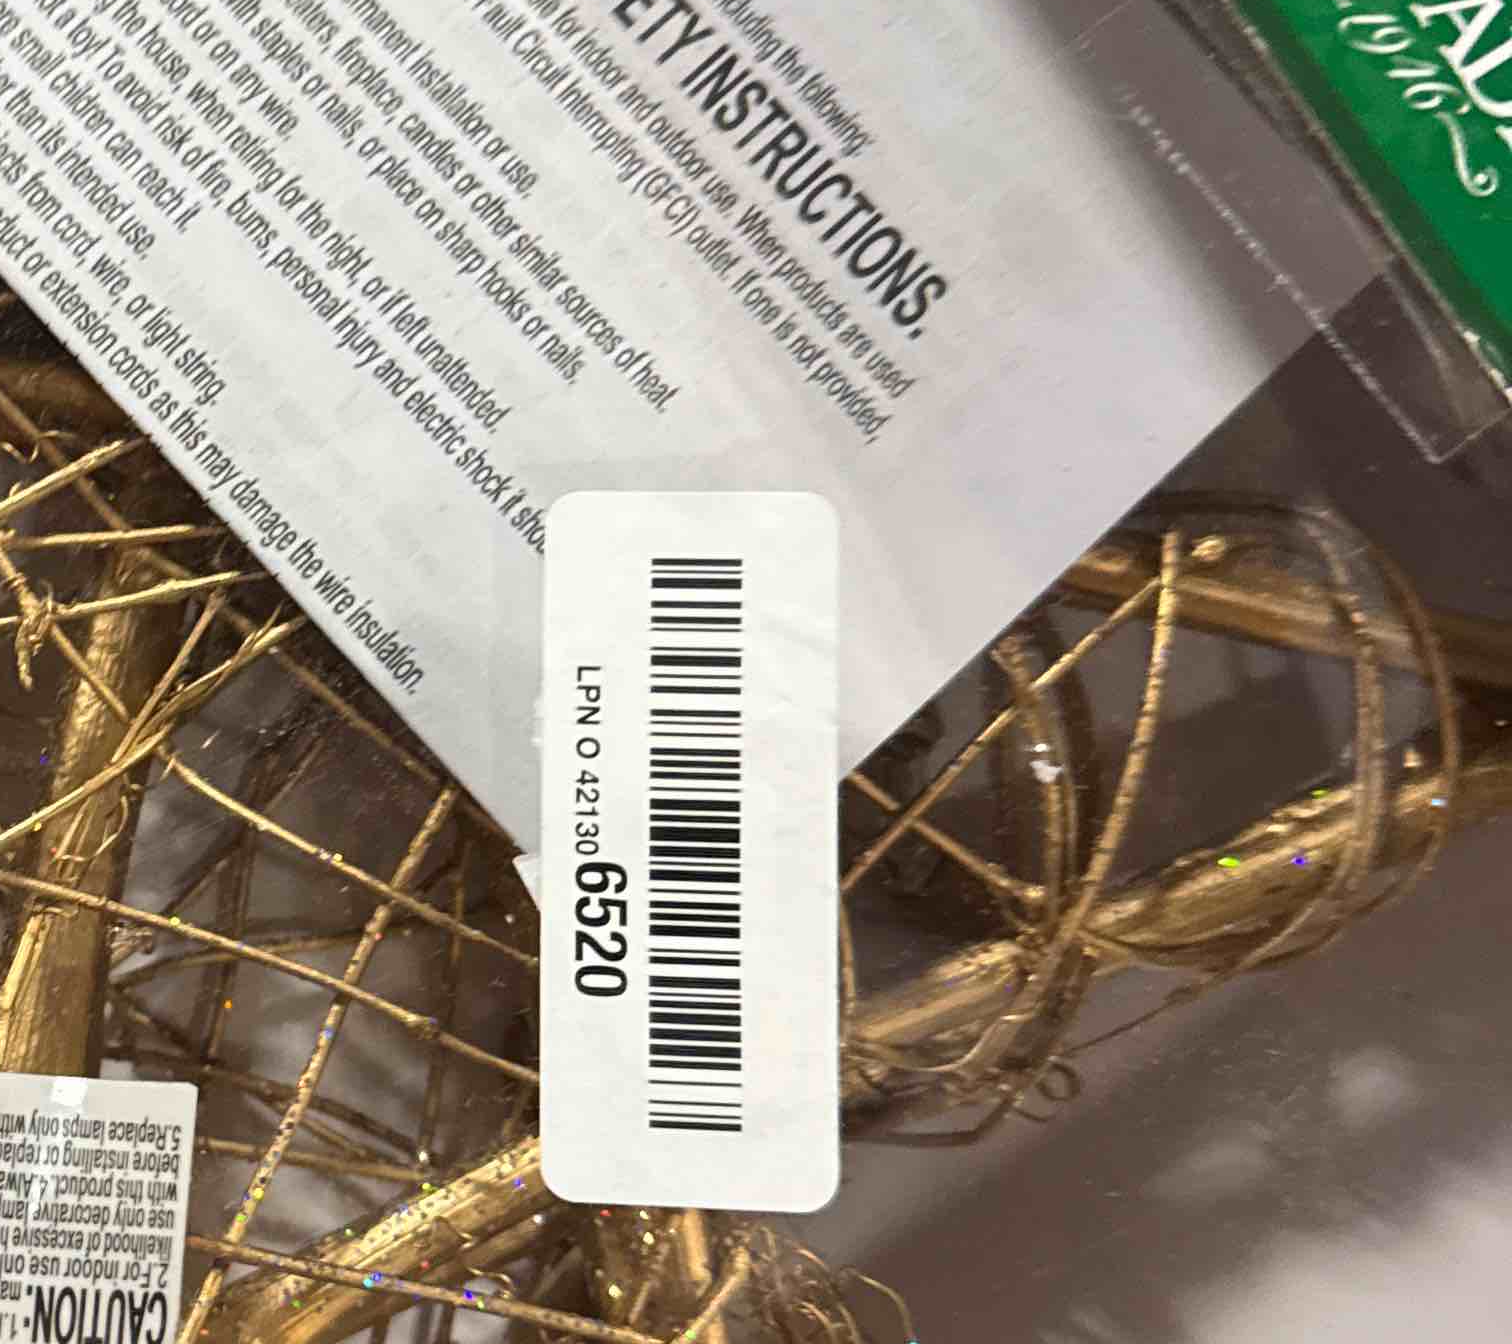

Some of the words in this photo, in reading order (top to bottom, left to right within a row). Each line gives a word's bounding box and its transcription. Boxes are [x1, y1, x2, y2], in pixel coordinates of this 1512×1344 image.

[133, 21, 196, 94] house,
[183, 77, 238, 135] when
[2, 85, 51, 138] than
[34, 119, 70, 158] its
[53, 140, 136, 225] intended
[115, 213, 159, 261] use.
[220, 121, 288, 194] retiring
[16, 169, 66, 224] from
[272, 173, 311, 213] for
[677, 41, 954, 342] INSTRUCTIONS.
[294, 197, 335, 240] the
[47, 209, 104, 268] cord,
[316, 227, 376, 289] night,
[86, 249, 136, 307] wire,
[359, 274, 391, 303] or
[123, 292, 156, 322] or
[376, 287, 410, 317] if
[137, 305, 192, 361] light
[387, 300, 431, 344] left
[170, 344, 231, 409] string.
[412, 330, 514, 435] unattended.
[19, 249, 53, 280] or
[37, 266, 122, 356] extension
[106, 342, 163, 400] cords
[147, 389, 180, 422] as
[166, 405, 210, 452] this
[191, 440, 242, 493] may
[224, 474, 301, 555] damage
[286, 536, 327, 580] the
[312, 566, 359, 616] wire
[343, 598, 430, 696] insulation.
[576, 666, 602, 725] LPN
[27, 1107, 59, 1142] only
[61, 1112, 105, 1146] lamps
[42, 1144, 59, 1166] or
[62, 1139, 129, 1176] installing
[131, 1151, 180, 1179] before
[115, 1178, 143, 1206] this
[146, 1180, 177, 1206] with
[112, 1202, 145, 1232] only
[147, 1208, 174, 1230] use
[11, 1225, 84, 1253] excessive
[83, 1231, 101, 1258] of
[102, 1231, 172, 1263] likelihood
[29, 1254, 60, 1276] use
[62, 1257, 119, 1286] indoor
